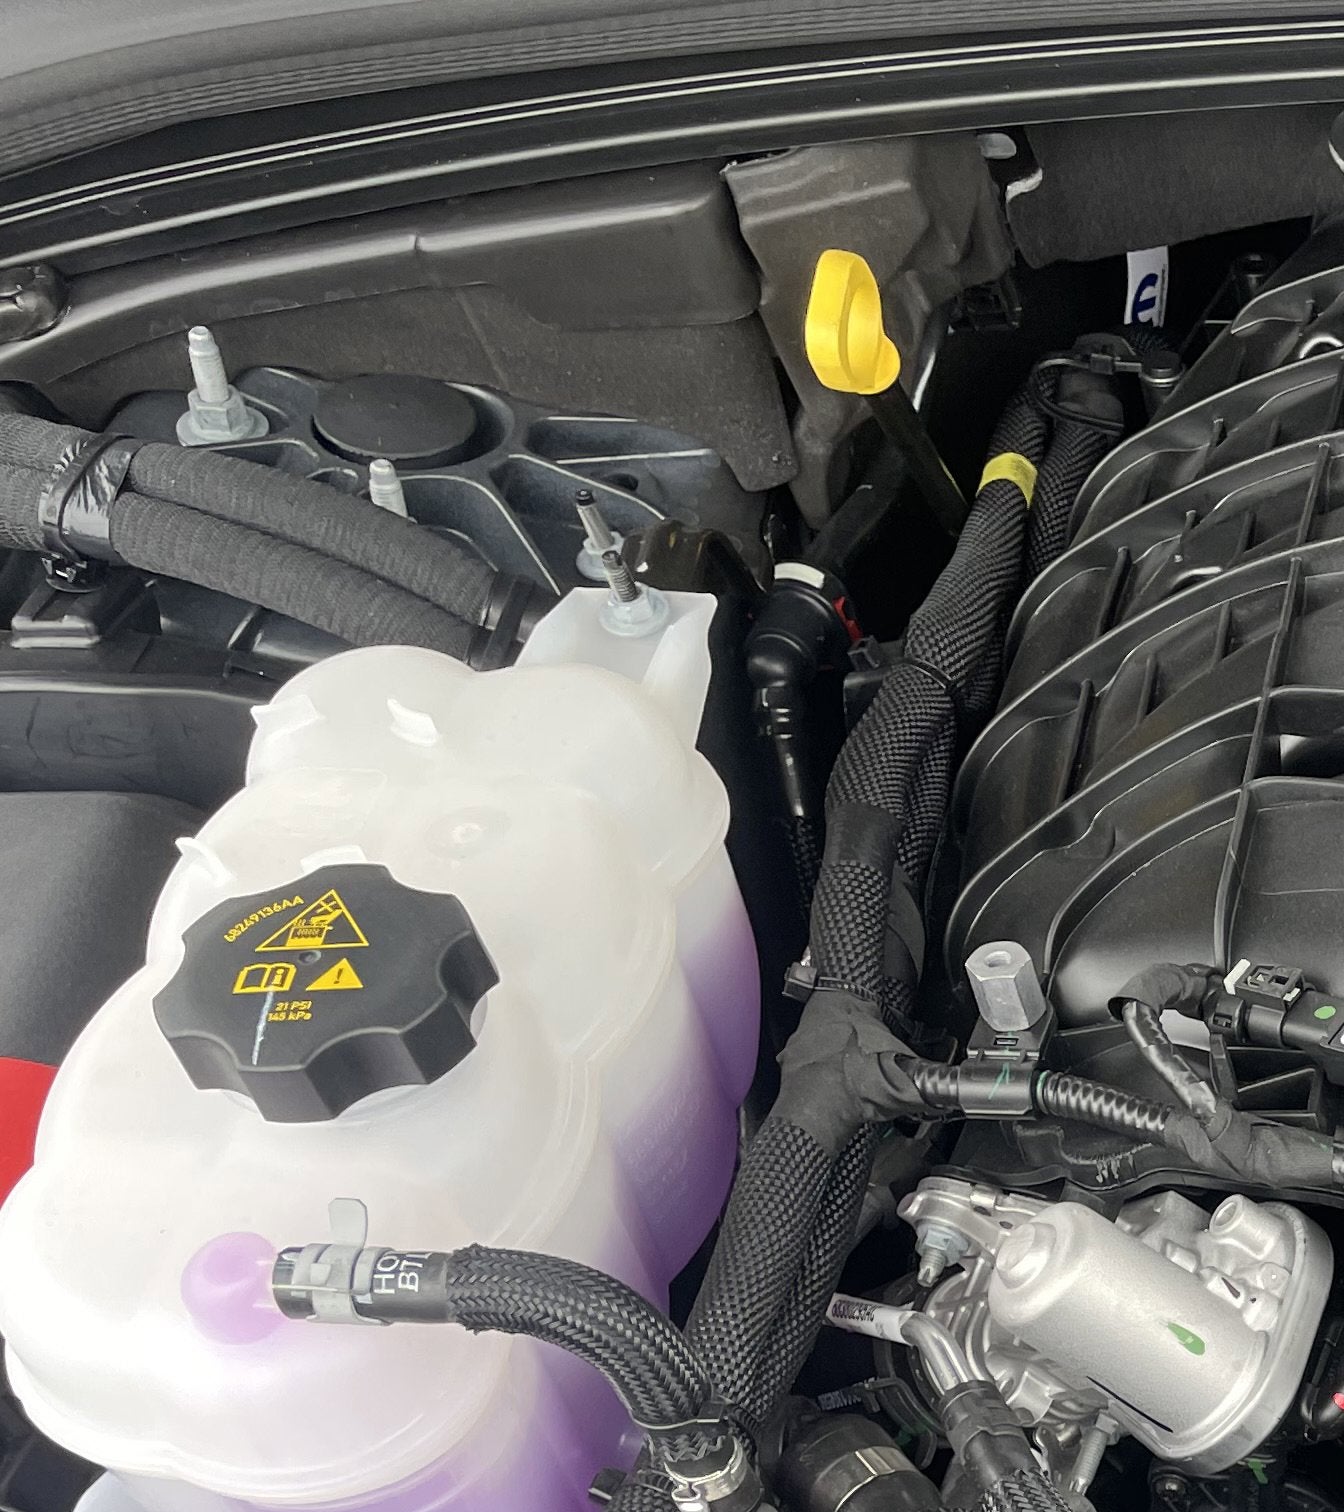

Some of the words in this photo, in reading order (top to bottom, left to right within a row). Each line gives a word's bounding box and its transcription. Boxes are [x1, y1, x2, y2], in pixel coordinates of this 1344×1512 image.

[223, 895, 305, 943] 68249136AA
[290, 1000, 312, 1011] PSI
[288, 1011, 313, 1021] kPa
